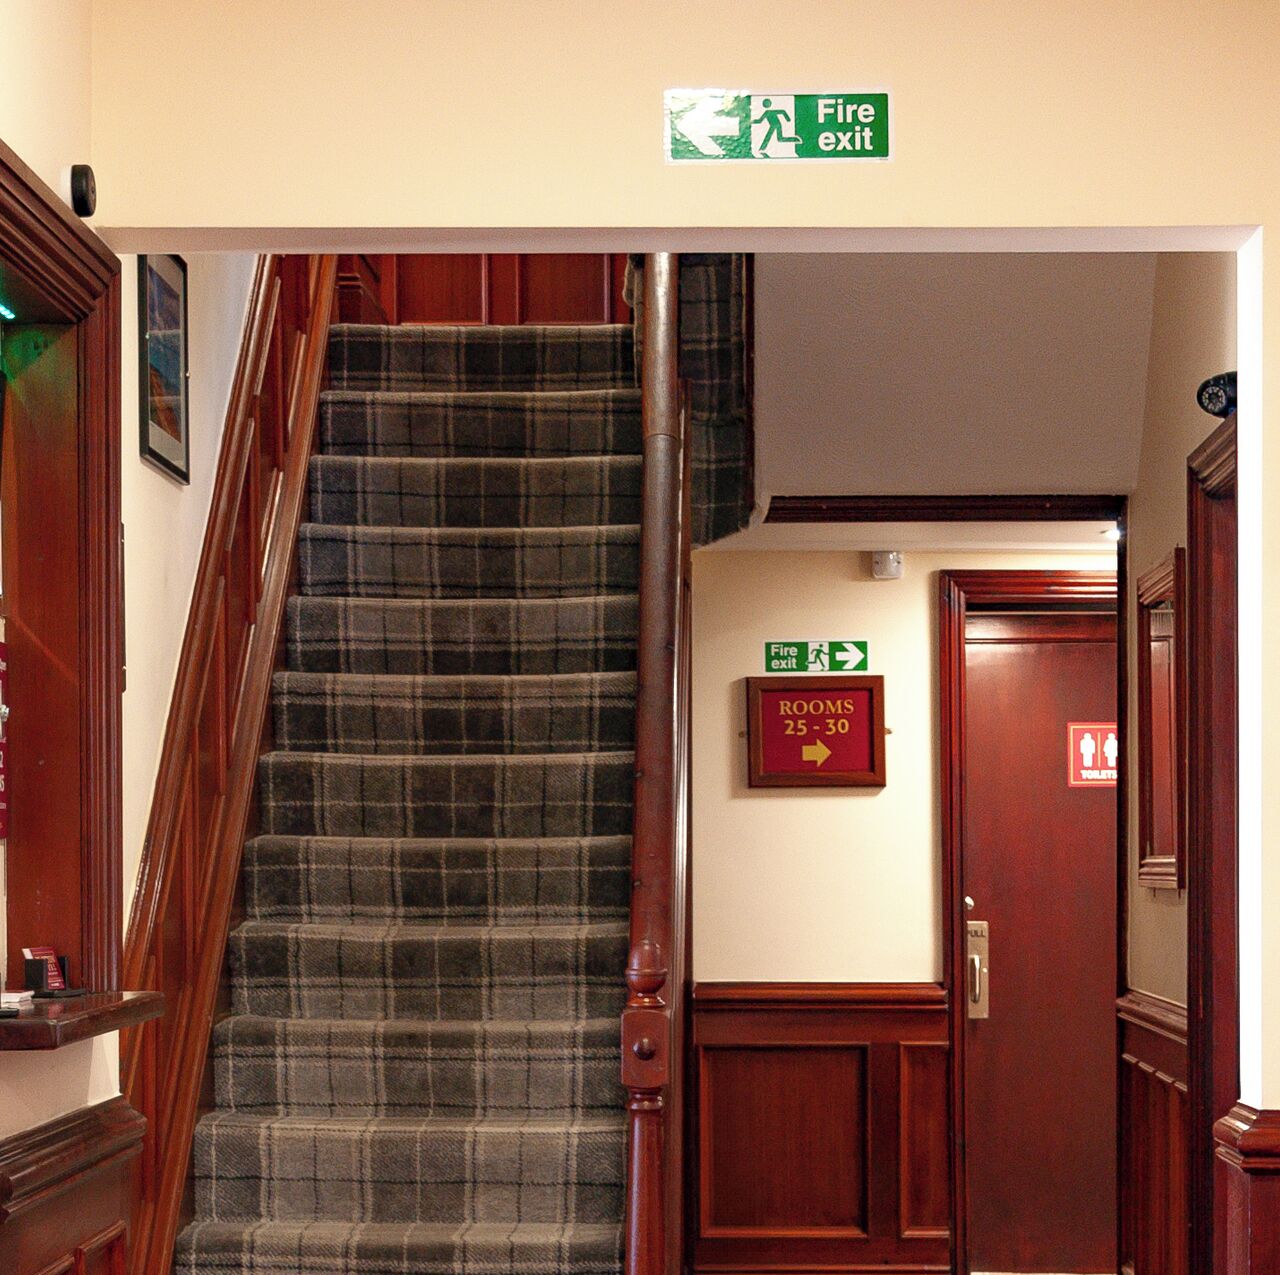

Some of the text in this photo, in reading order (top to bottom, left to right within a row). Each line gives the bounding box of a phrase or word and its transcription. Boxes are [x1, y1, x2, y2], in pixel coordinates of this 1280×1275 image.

[817, 98, 876, 124] Fire
[817, 125, 874, 152] exit
[770, 643, 798, 657] Fire
[770, 656, 797, 669] exit
[778, 698, 855, 716] ROOMS
[783, 719, 808, 736] 25
[824, 718, 850, 736] 30
